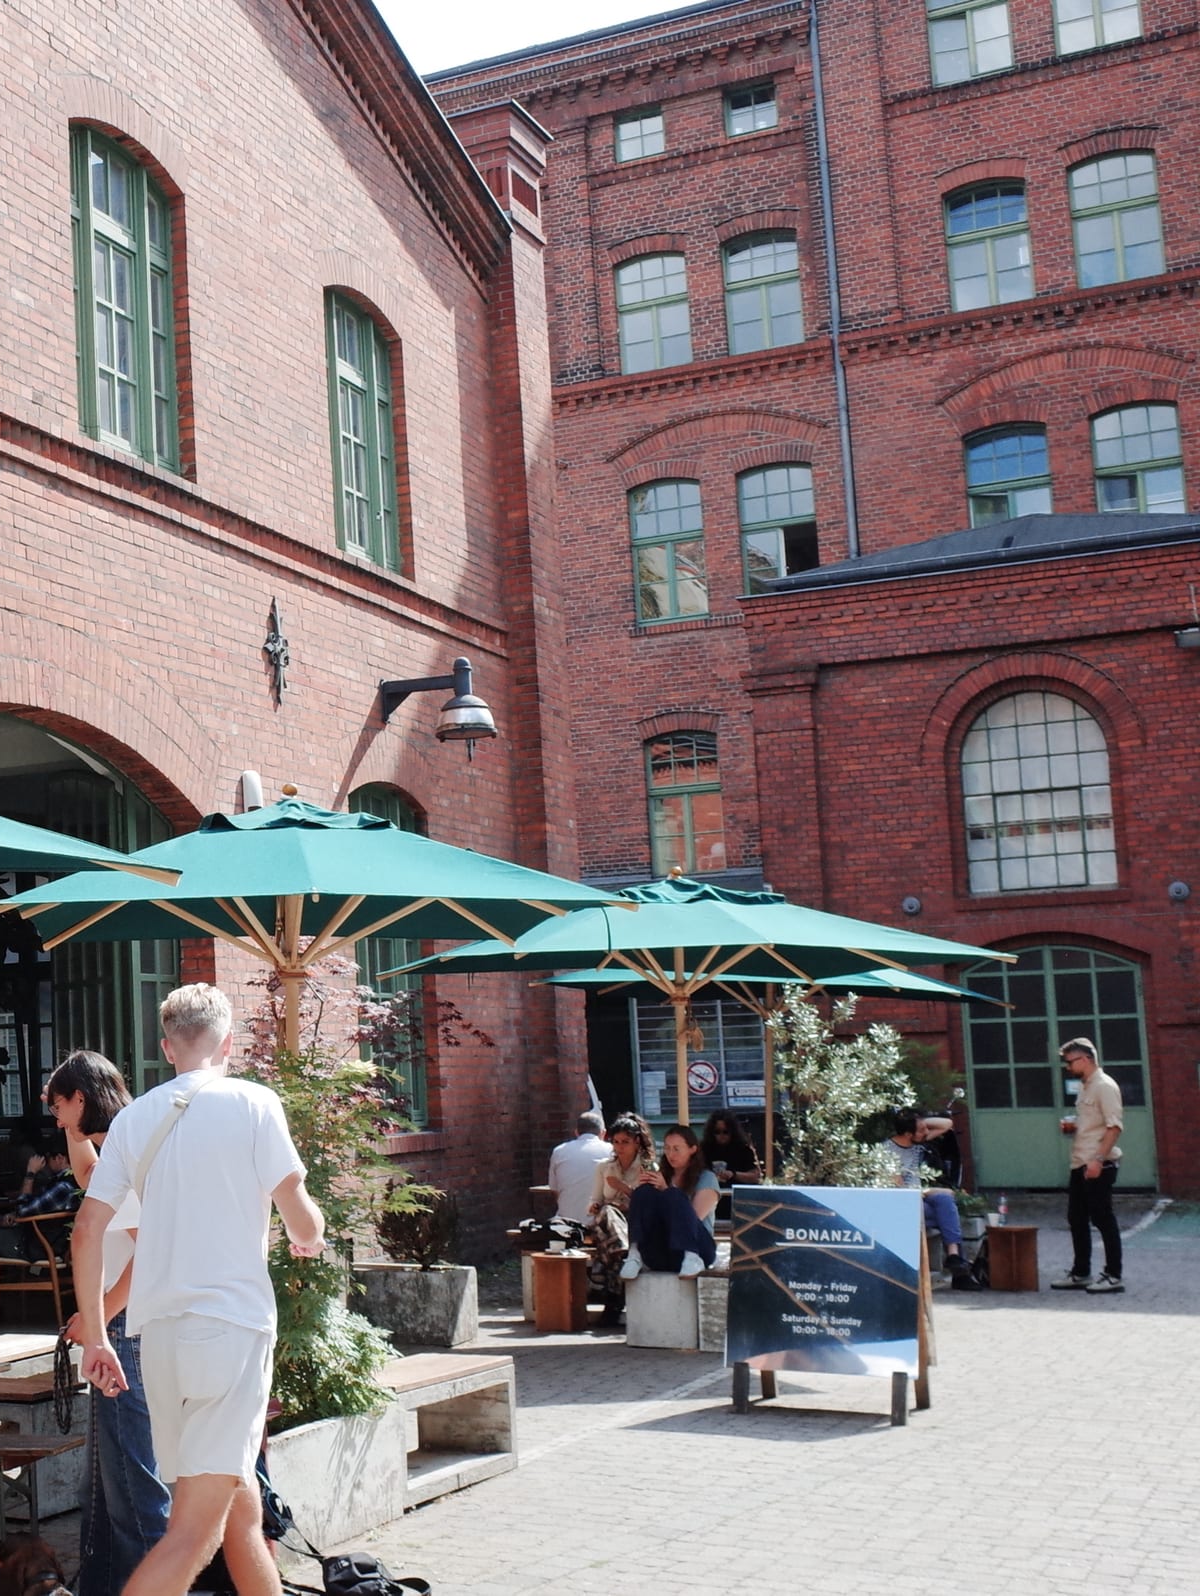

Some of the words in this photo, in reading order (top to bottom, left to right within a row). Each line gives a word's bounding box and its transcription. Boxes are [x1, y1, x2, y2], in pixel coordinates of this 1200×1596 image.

[785, 1228, 864, 1242] BONANZA
[788, 1281, 822, 1292] Monday
[830, 1282, 858, 1294] Friday
[795, 1292, 816, 1301] 9:00
[825, 1294, 850, 1303] 18:00
[782, 1313, 820, 1324] Saturday
[830, 1316, 862, 1327] Sunday
[792, 1325, 817, 1335] 10:00
[826, 1327, 851, 1337] 18:00
